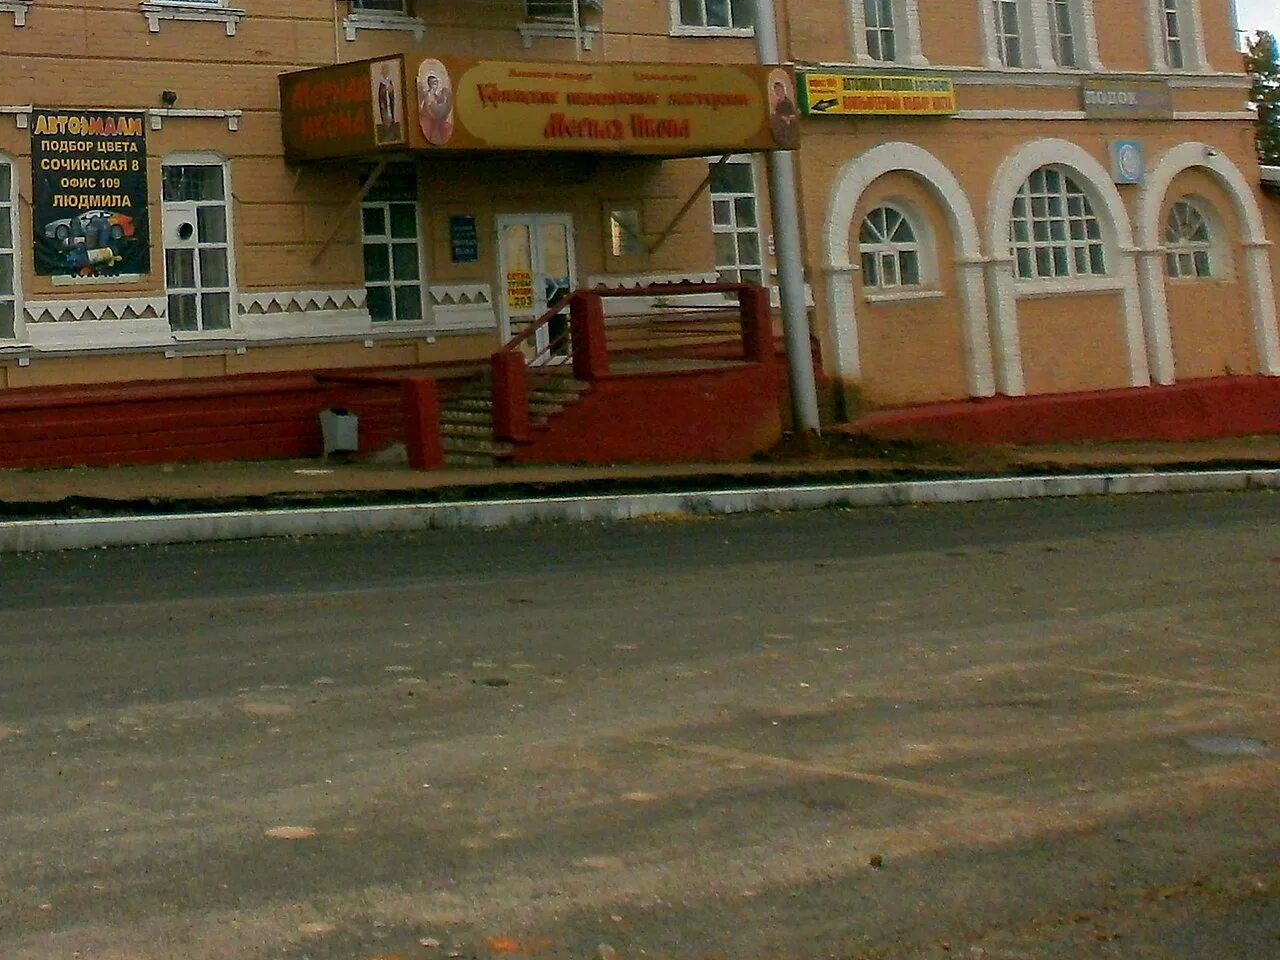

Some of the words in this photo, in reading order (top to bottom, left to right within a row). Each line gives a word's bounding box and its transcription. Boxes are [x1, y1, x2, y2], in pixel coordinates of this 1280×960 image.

[41, 140, 93, 153] ПОДБОР
[97, 141, 138, 153] ЦВЕТА
[41, 159, 128, 171] СОЧИНСКАЯ
[132, 160, 139, 171] 8
[61, 178, 96, 188] ОФИС
[100, 178, 120, 189] 109
[53, 195, 131, 209] ЛЮДМИЛА
